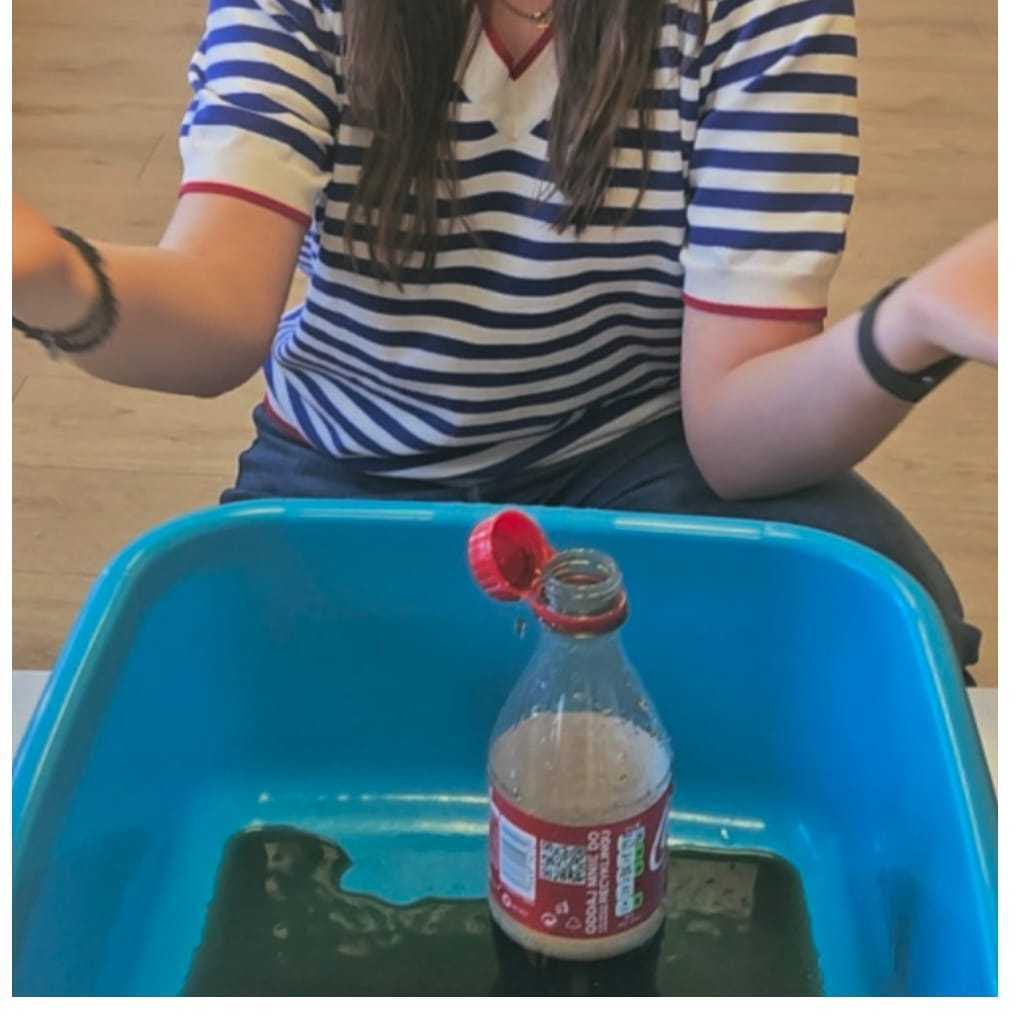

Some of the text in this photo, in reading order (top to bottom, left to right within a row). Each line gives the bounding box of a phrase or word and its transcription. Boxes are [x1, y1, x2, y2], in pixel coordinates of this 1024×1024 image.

[587, 832, 599, 851] DO
[598, 830, 611, 904] RECYKLINGU
[585, 890, 597, 934] ODDAJ
